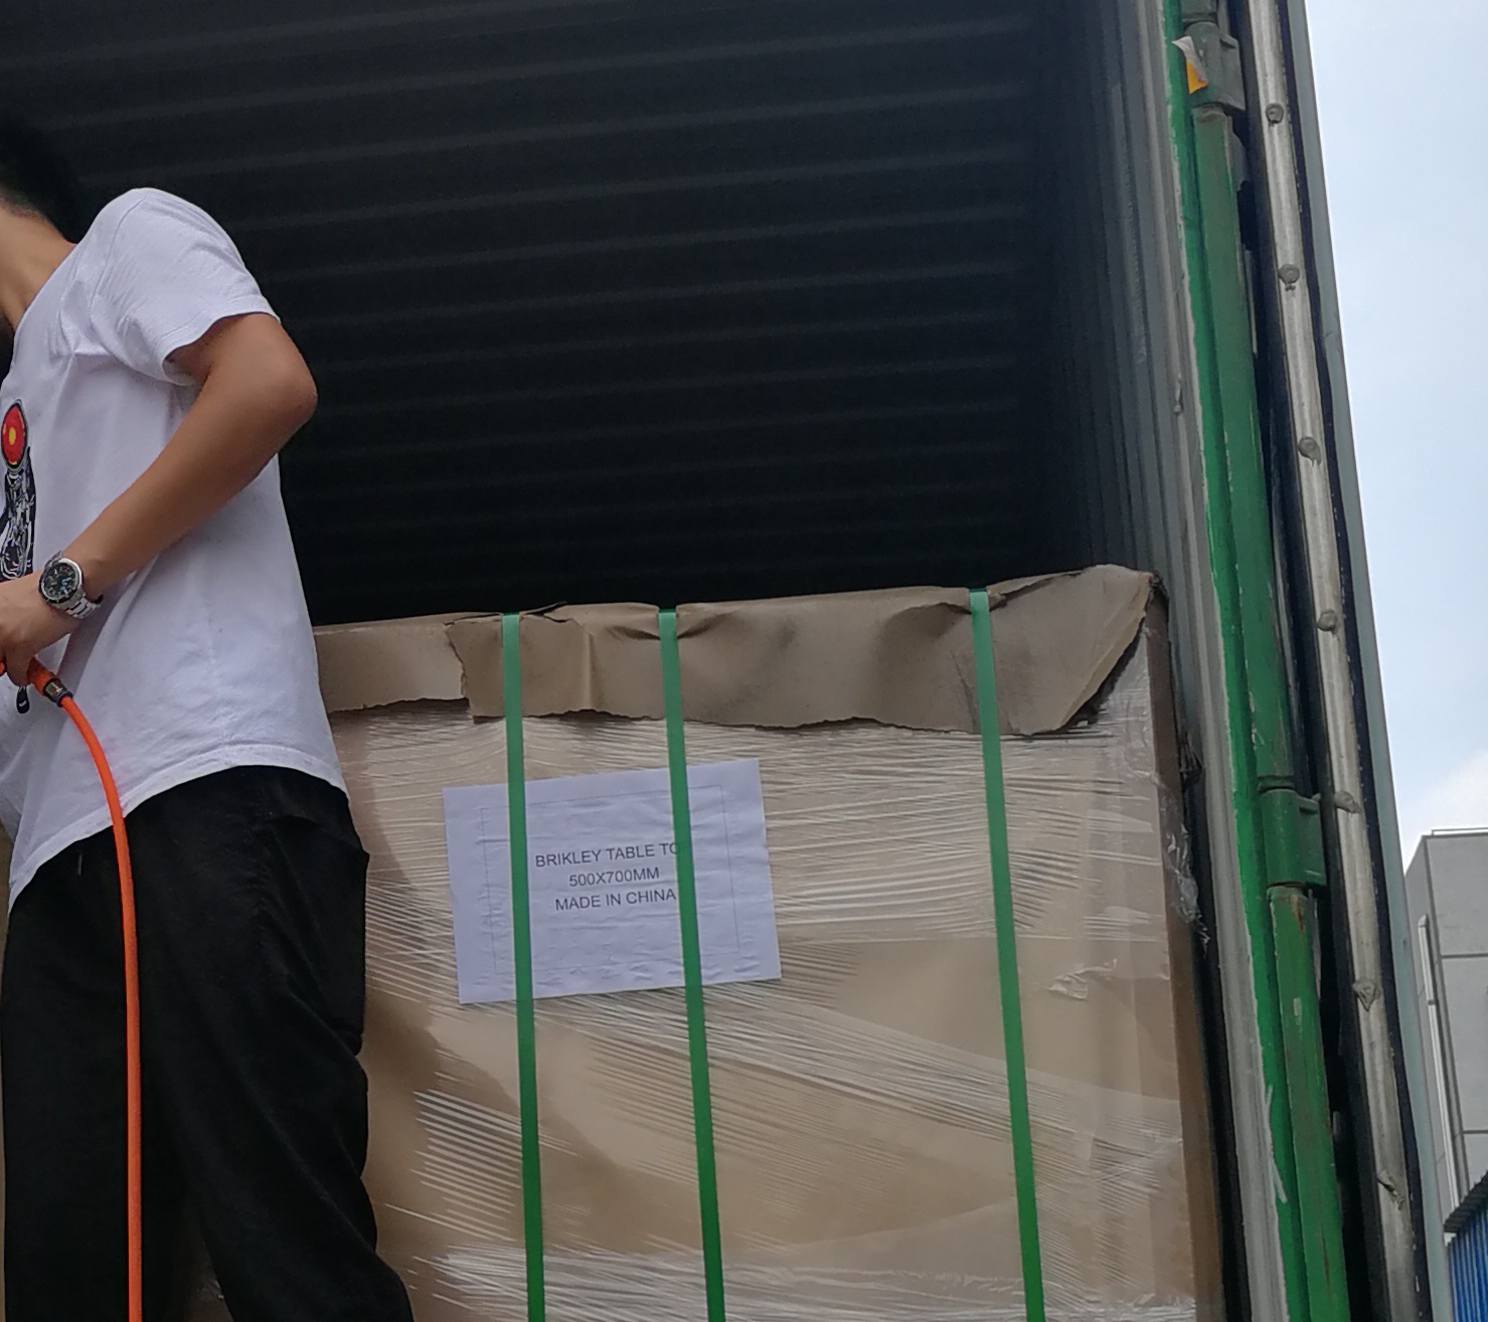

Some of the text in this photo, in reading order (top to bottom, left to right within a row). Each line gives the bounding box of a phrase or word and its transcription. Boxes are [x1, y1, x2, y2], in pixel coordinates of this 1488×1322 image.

[535, 849, 602, 868] BRIKLEY
[606, 844, 655, 861] TABLE
[569, 867, 660, 887] 500X700MM
[555, 888, 677, 911] MADE IN CHINA
